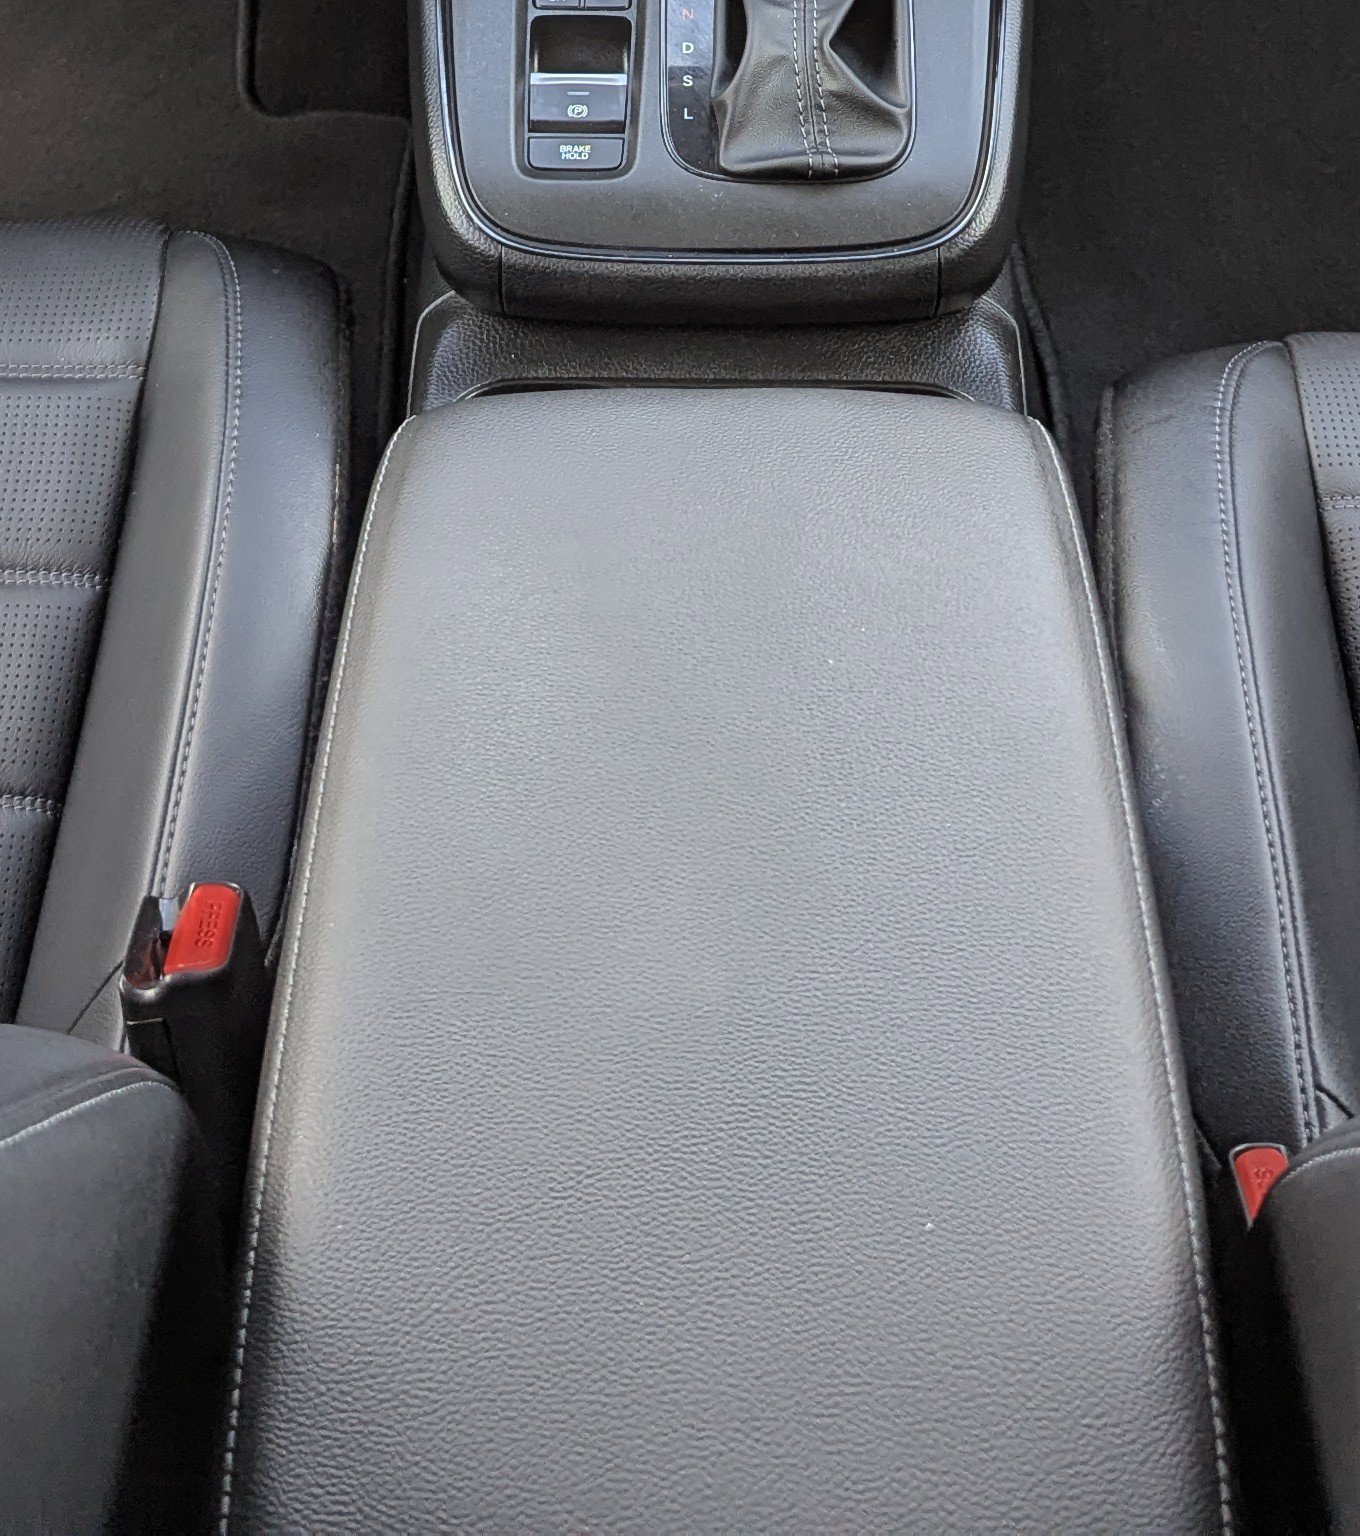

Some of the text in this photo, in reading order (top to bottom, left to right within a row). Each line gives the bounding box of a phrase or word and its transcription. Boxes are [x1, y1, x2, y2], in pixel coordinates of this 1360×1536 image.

[682, 8, 694, 20] N
[682, 42, 694, 54] D
[682, 75, 694, 87] S
[683, 107, 694, 120] L
[559, 145, 592, 153] BRAKE
[561, 152, 589, 160] HOLD
